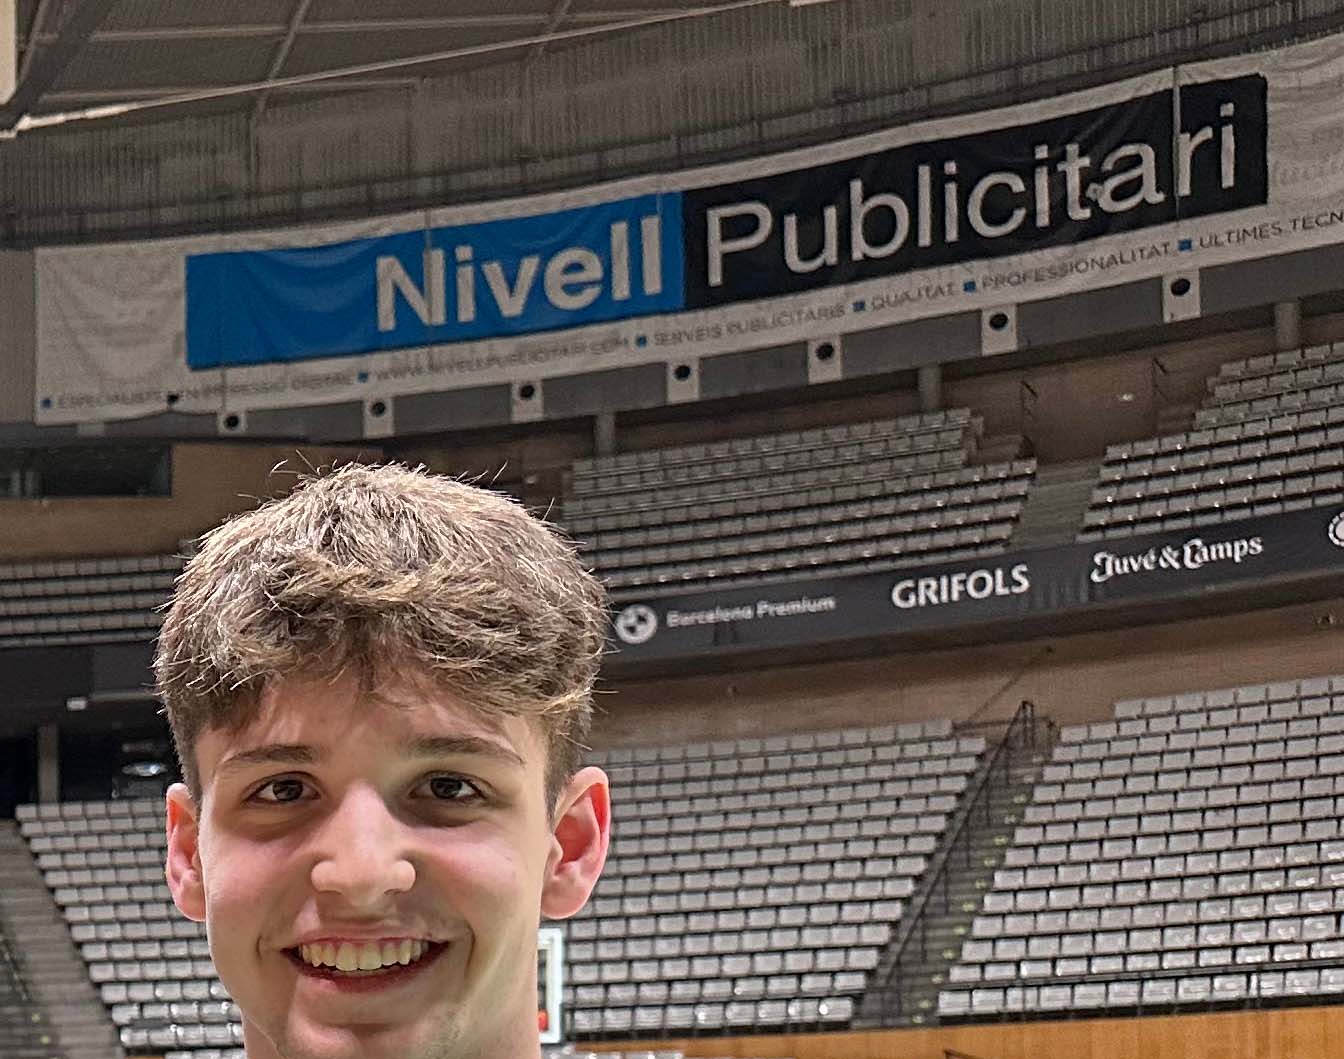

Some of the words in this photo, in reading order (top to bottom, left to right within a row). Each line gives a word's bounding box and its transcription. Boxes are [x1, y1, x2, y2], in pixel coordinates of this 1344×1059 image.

[376, 215, 662, 331] Nivell
[706, 101, 1235, 287] Publicitari
[981, 240, 1171, 290] PROFESSIONALITAT
[890, 564, 1032, 609] GRIFOLS
[666, 604, 754, 628] Barcelona
[756, 596, 836, 618] Premium
